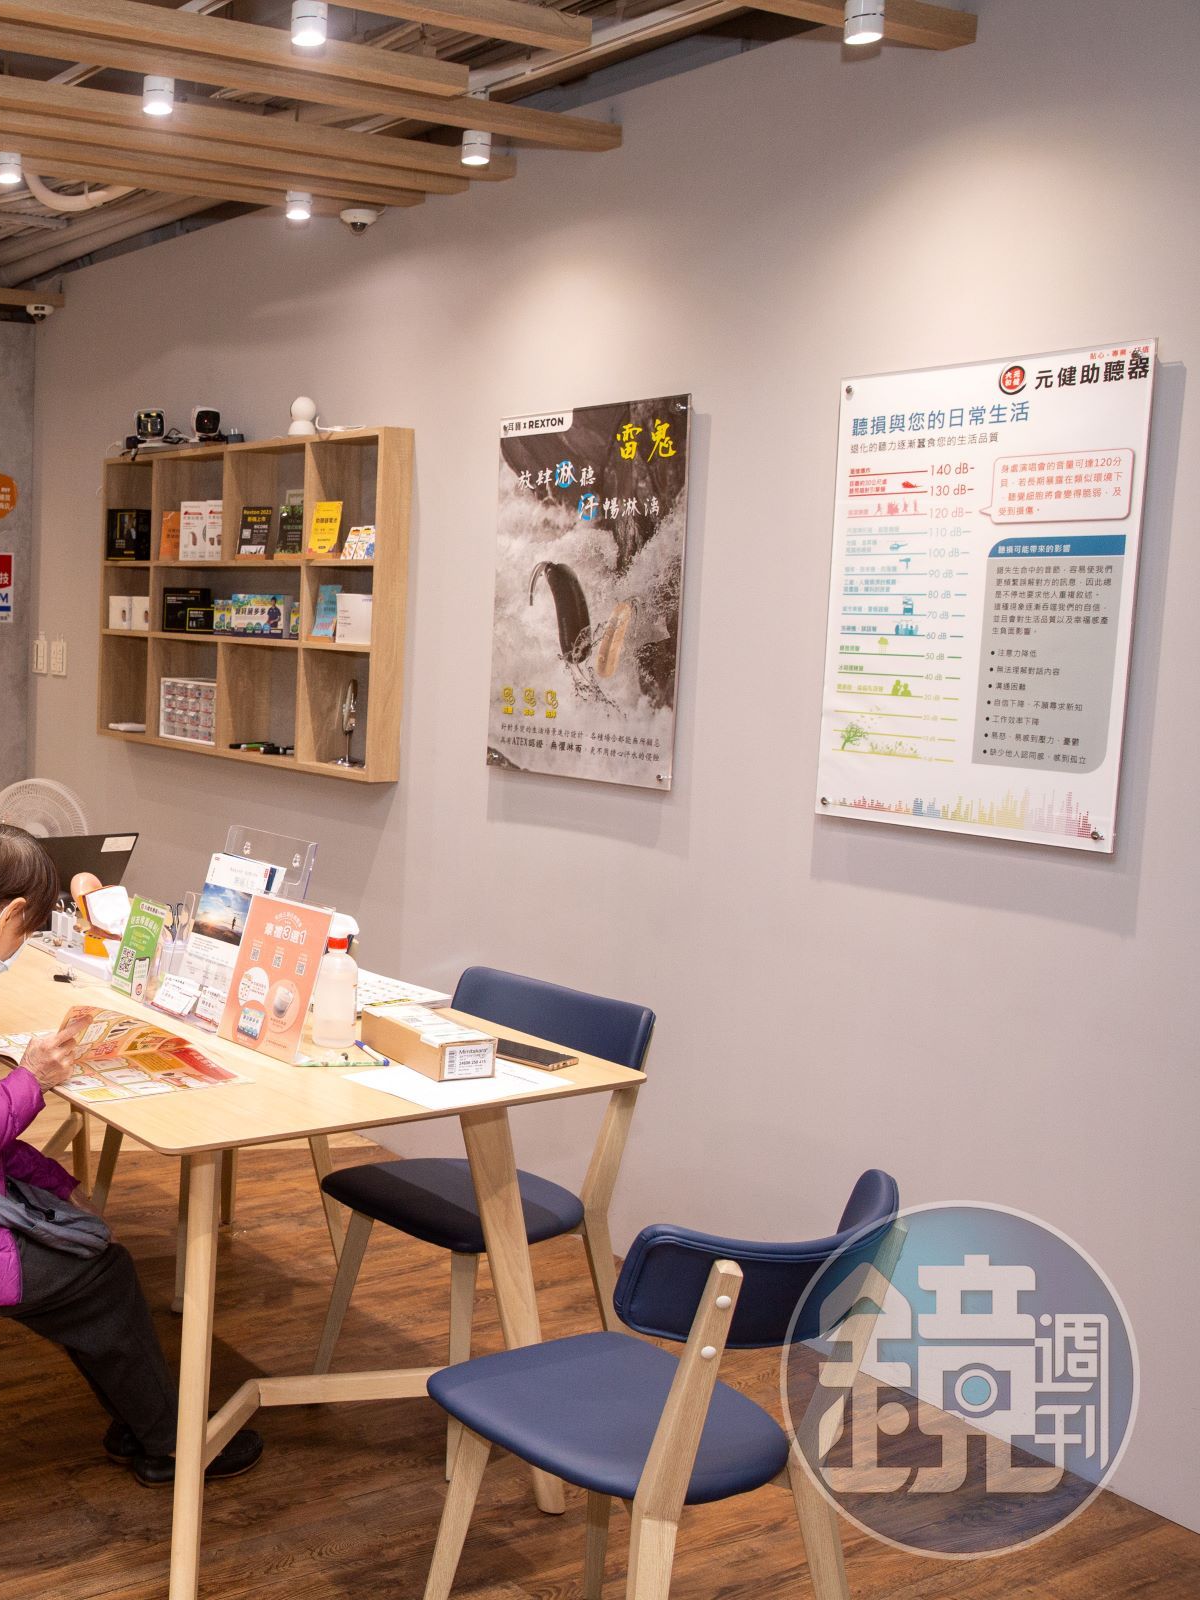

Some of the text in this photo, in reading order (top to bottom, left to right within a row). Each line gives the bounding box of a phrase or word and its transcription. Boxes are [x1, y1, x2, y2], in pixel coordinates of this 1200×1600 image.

[1034, 356, 1150, 390] 元健助聽器
[528, 416, 564, 429] REXTON
[851, 400, 1031, 437] 聽損與您的日常生活
[616, 418, 677, 463] 雷鬼
[850, 431, 1000, 454] 退化的聽力逐漸蠶食您的生活品質
[930, 462, 969, 476] 140 dB
[518, 460, 597, 491] 放肆淋聽
[930, 485, 967, 497] 130 dB
[579, 494, 660, 520] 汗暢淋漓
[929, 507, 964, 519] 120 dB
[929, 527, 962, 537] 110 dB
[928, 547, 960, 558] 100 dB
[928, 569, 954, 578] 90 dB
[927, 590, 951, 599] 80 dB
[926, 611, 949, 620] 70 dB
[937, 632, 947, 640] dB
[936, 653, 945, 661] dB
